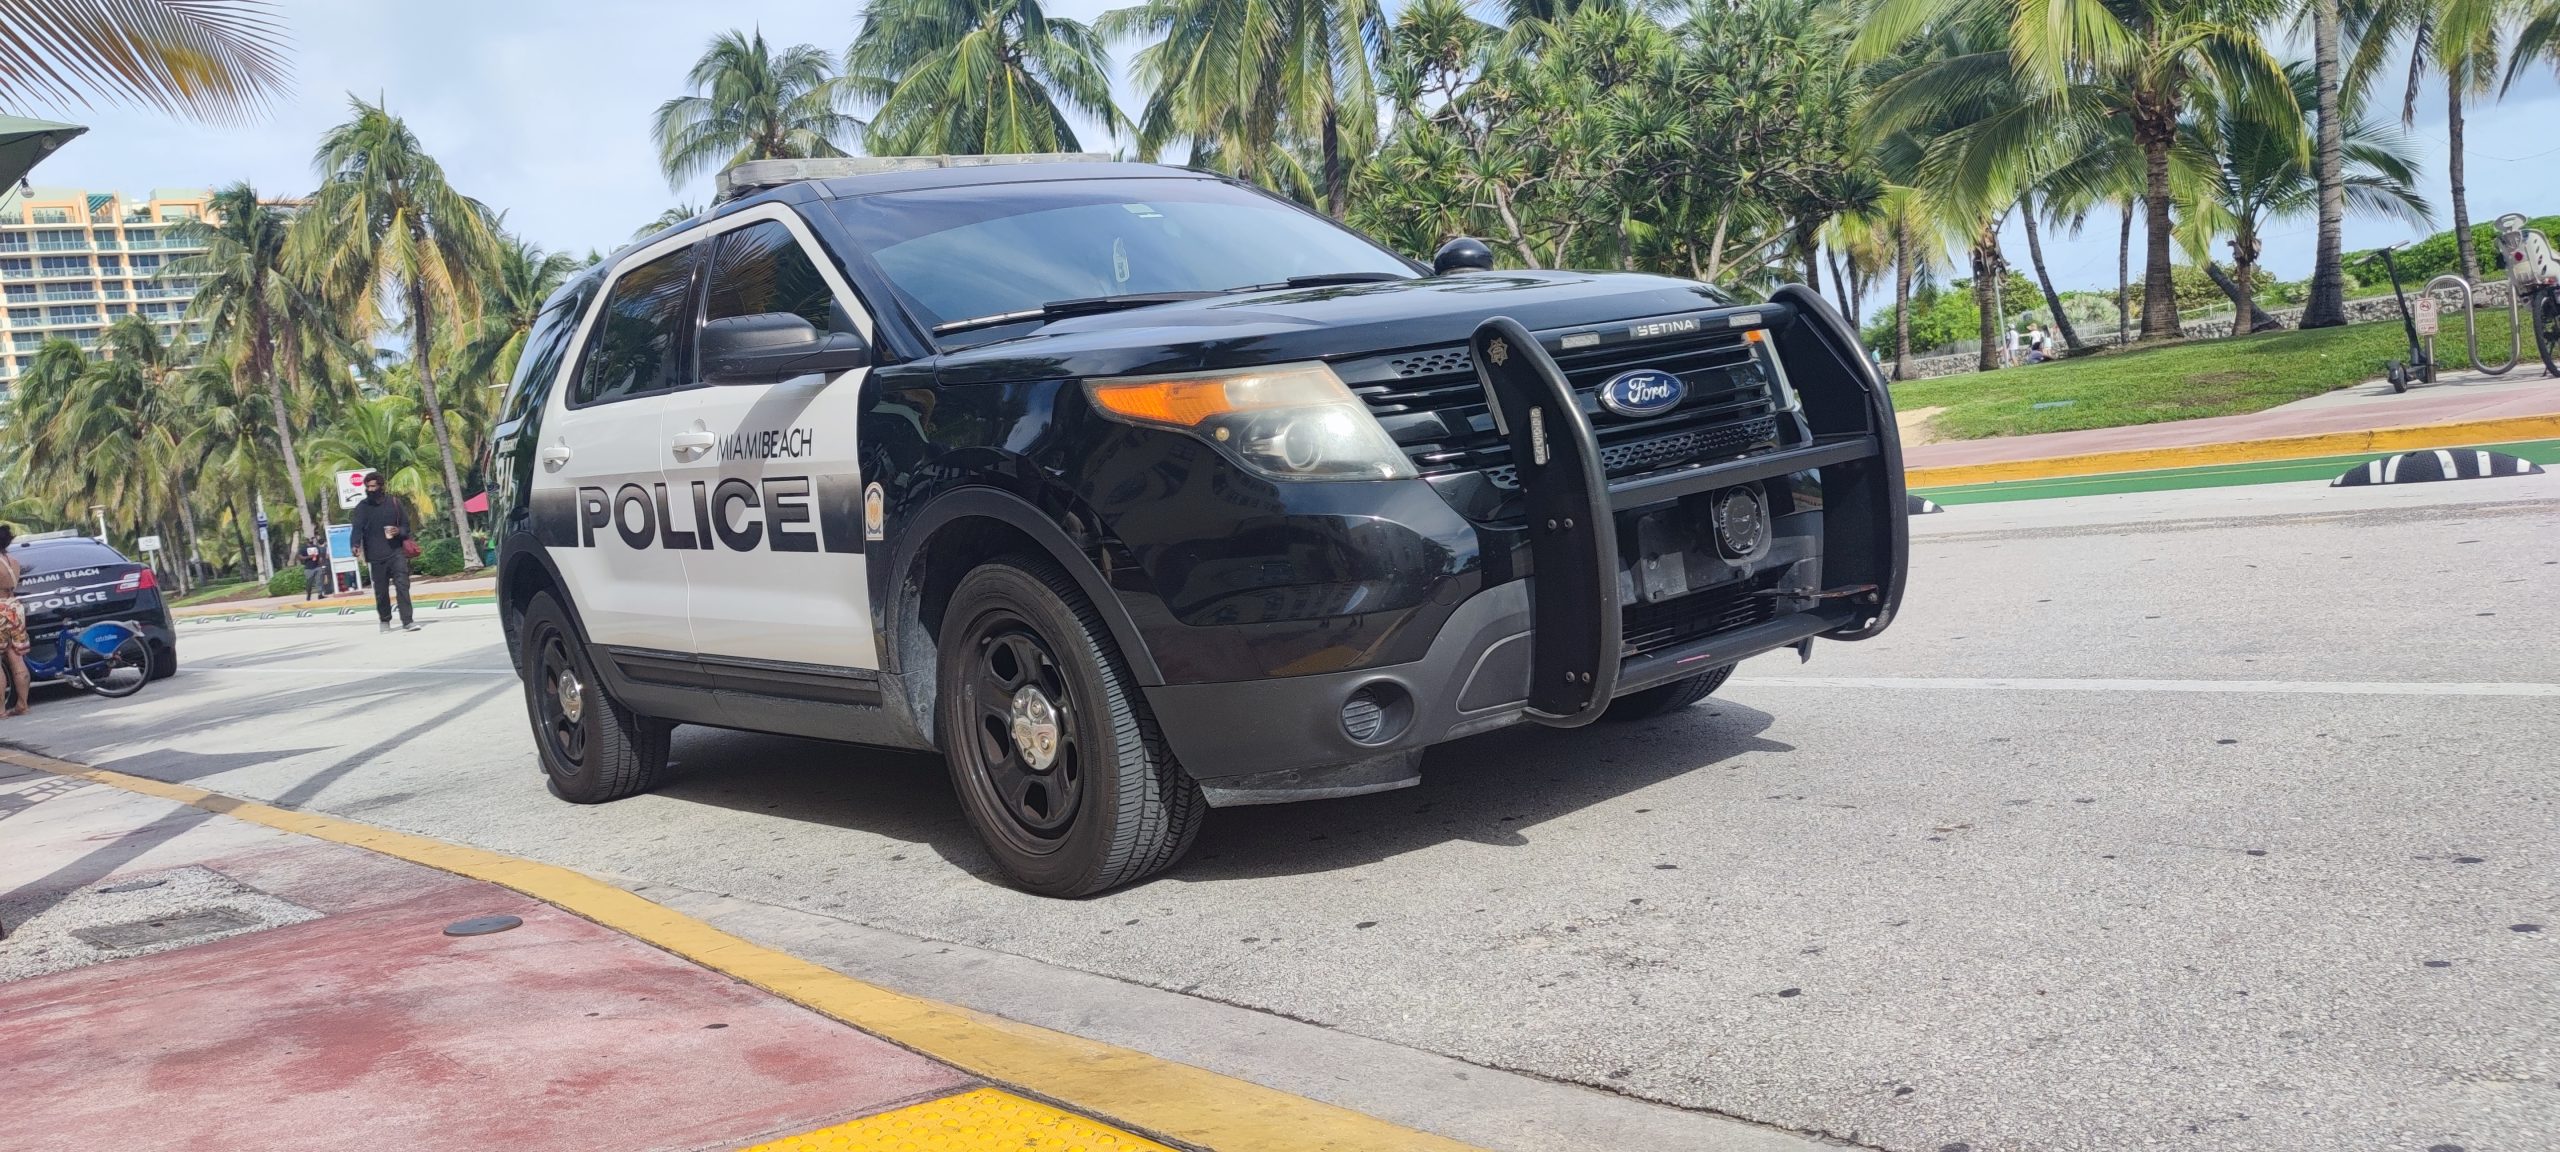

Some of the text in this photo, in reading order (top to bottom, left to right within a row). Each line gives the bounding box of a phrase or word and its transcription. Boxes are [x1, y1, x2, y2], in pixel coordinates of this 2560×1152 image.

[1637, 320, 1694, 337] SETINA
[1628, 376, 1670, 403] Ford
[579, 476, 819, 553] POLICE
[22, 568, 100, 586] MIAMI BEACH
[29, 591, 108, 612] POLICE
